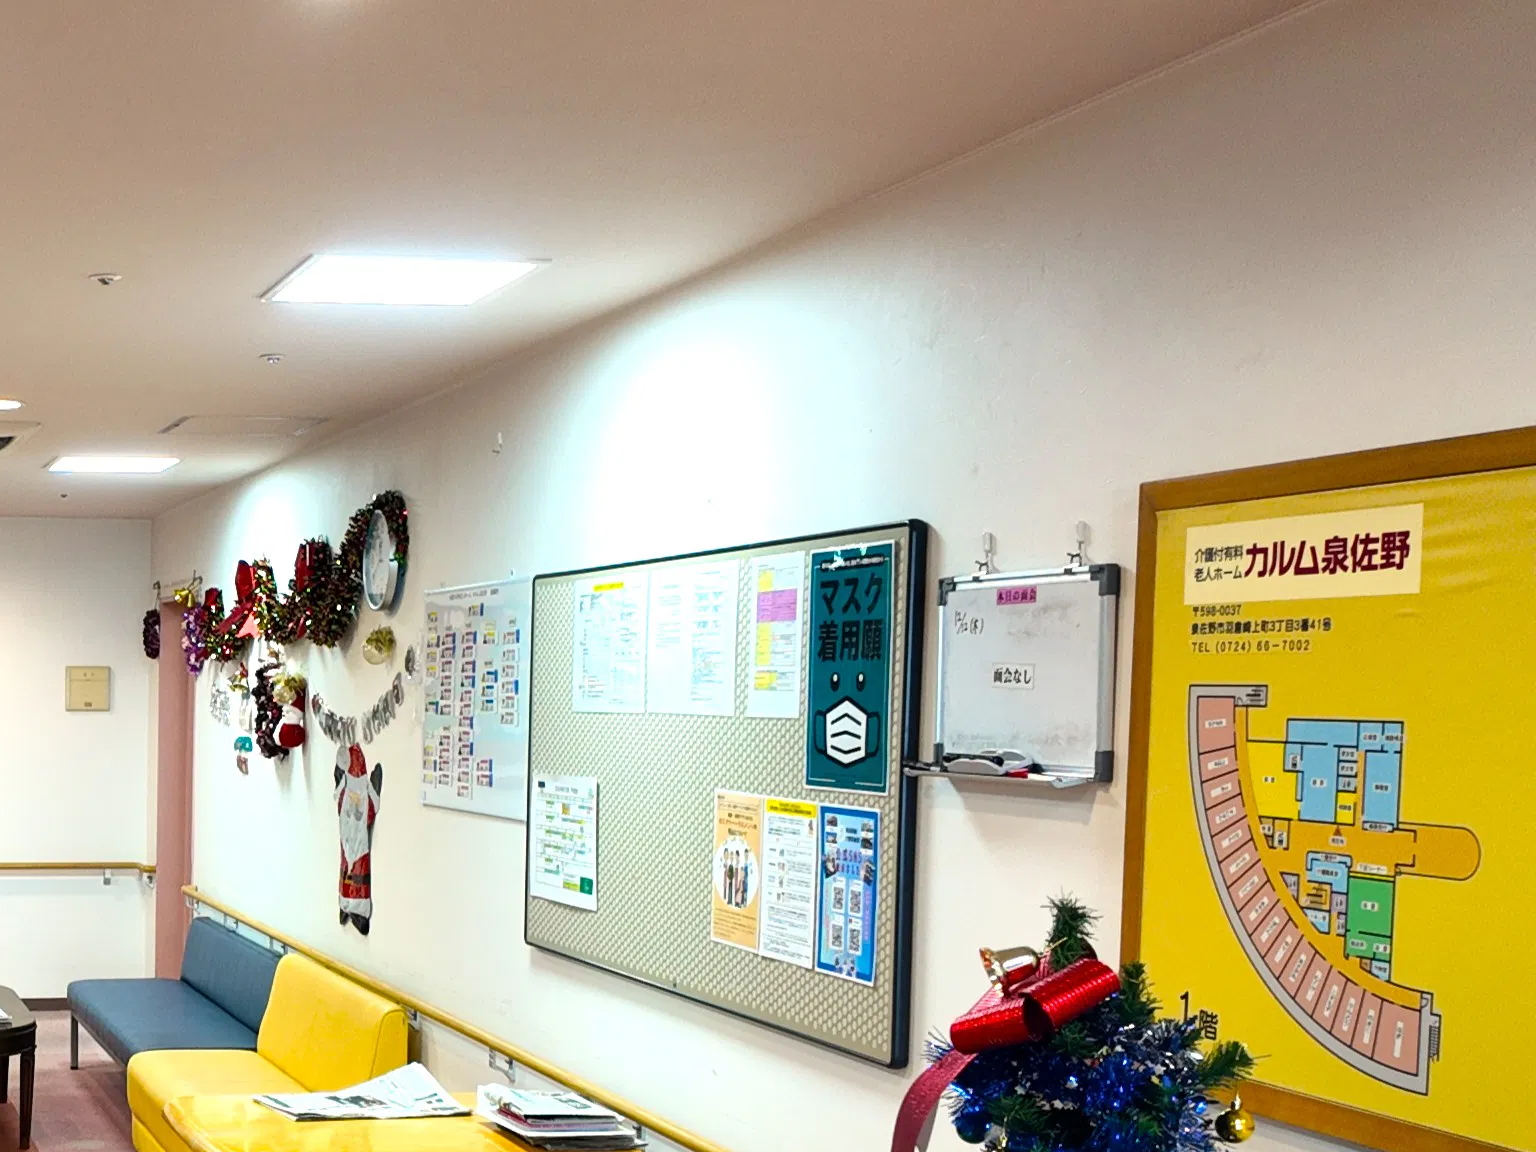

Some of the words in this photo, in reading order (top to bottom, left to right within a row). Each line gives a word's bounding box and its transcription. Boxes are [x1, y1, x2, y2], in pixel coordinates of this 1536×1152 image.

[1194, 545, 1244, 564] 介護付有料
[1244, 530, 1411, 578] カルム泉佐野
[1194, 565, 1242, 582] 老人ホーム
[819, 572, 883, 615] マスク
[817, 619, 884, 663] 着用願
[1191, 641, 1210, 653] TEL
[993, 666, 1033, 685] 面会なし
